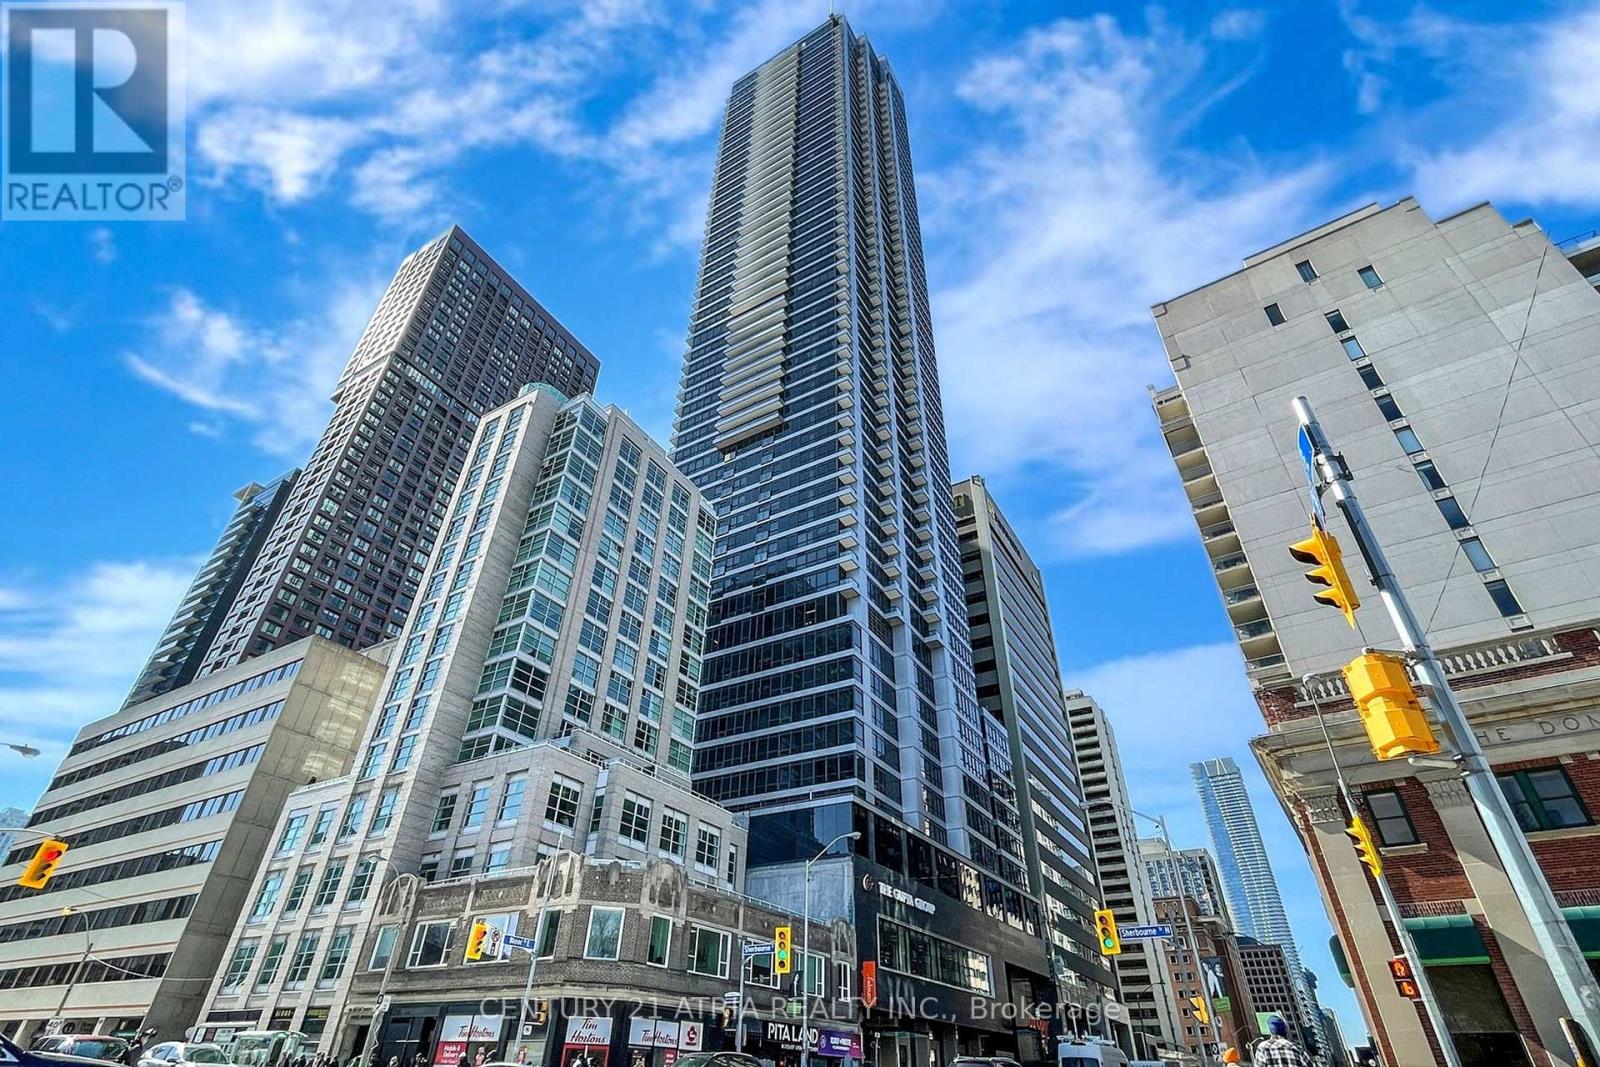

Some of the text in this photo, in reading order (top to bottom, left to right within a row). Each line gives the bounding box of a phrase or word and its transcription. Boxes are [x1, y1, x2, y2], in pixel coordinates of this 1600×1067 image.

[1474, 727, 1511, 744] HE
[1121, 928, 1157, 938] Sherbourne
[1164, 925, 1171, 934] N
[744, 945, 771, 953] Sherbourne
[582, 1018, 598, 1030] Tim
[570, 1029, 605, 1044] Hortons
